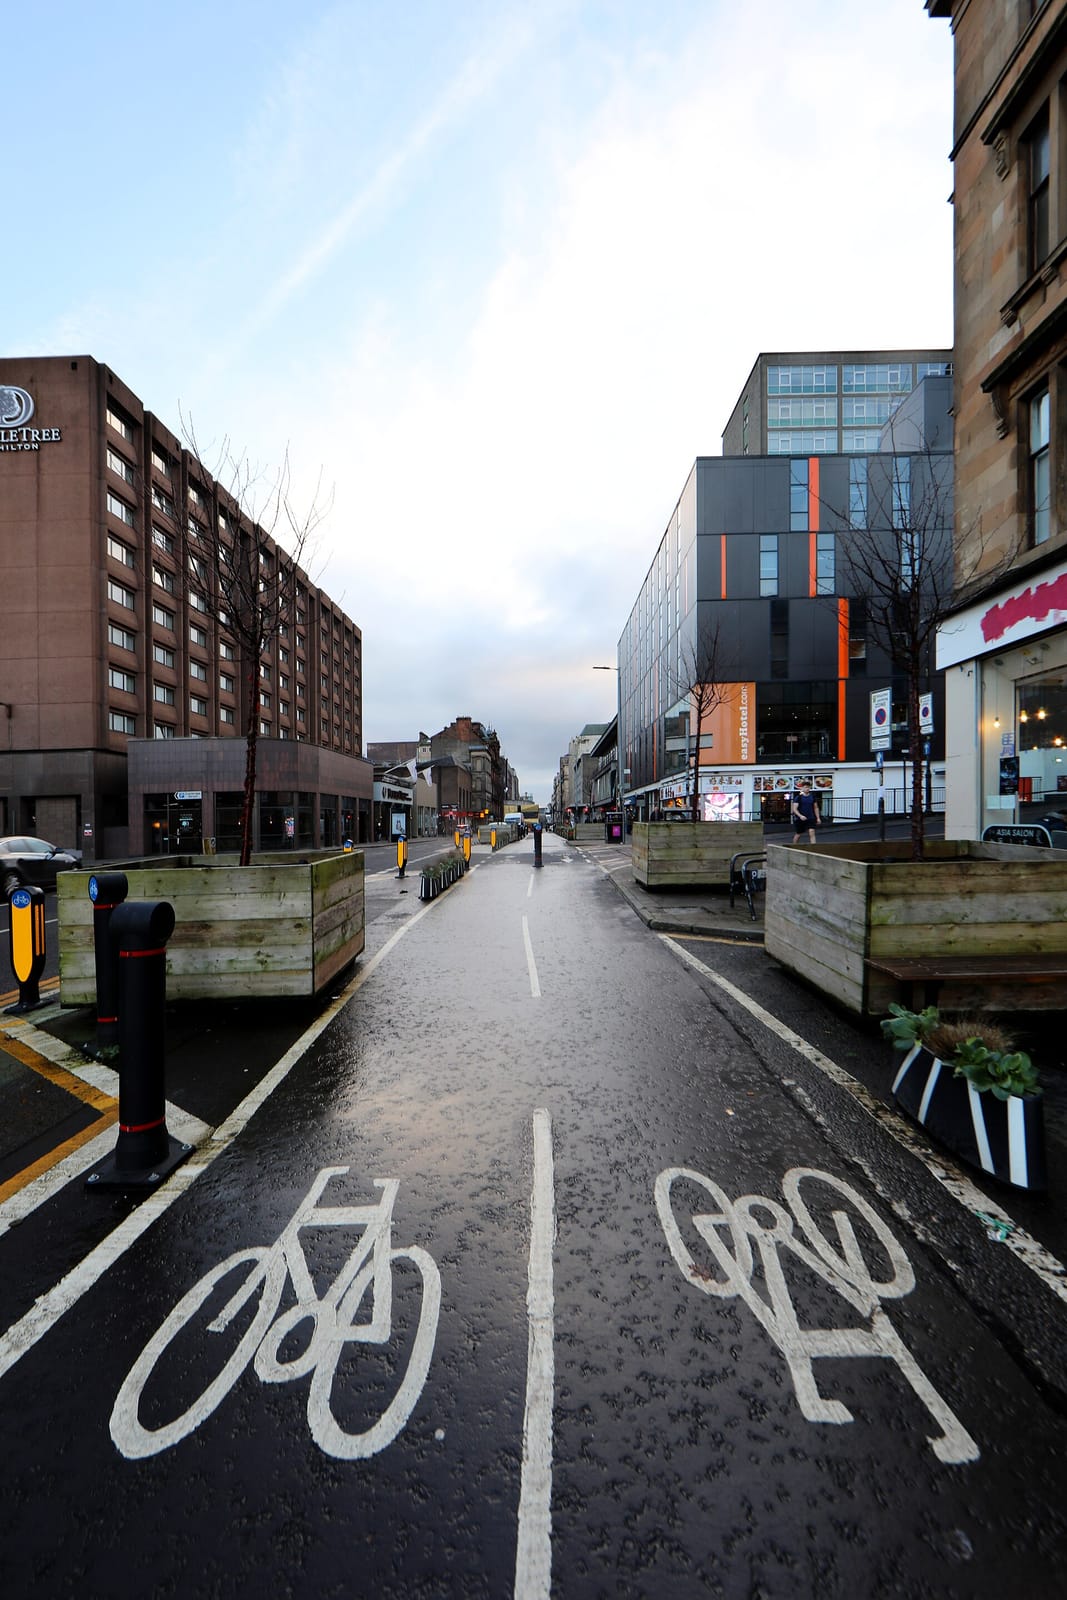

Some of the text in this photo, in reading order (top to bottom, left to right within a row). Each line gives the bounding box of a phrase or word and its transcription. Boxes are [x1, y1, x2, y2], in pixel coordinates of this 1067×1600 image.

[739, 685, 749, 761] easyHotel.com
[996, 828, 1035, 837] ASIA SALON
